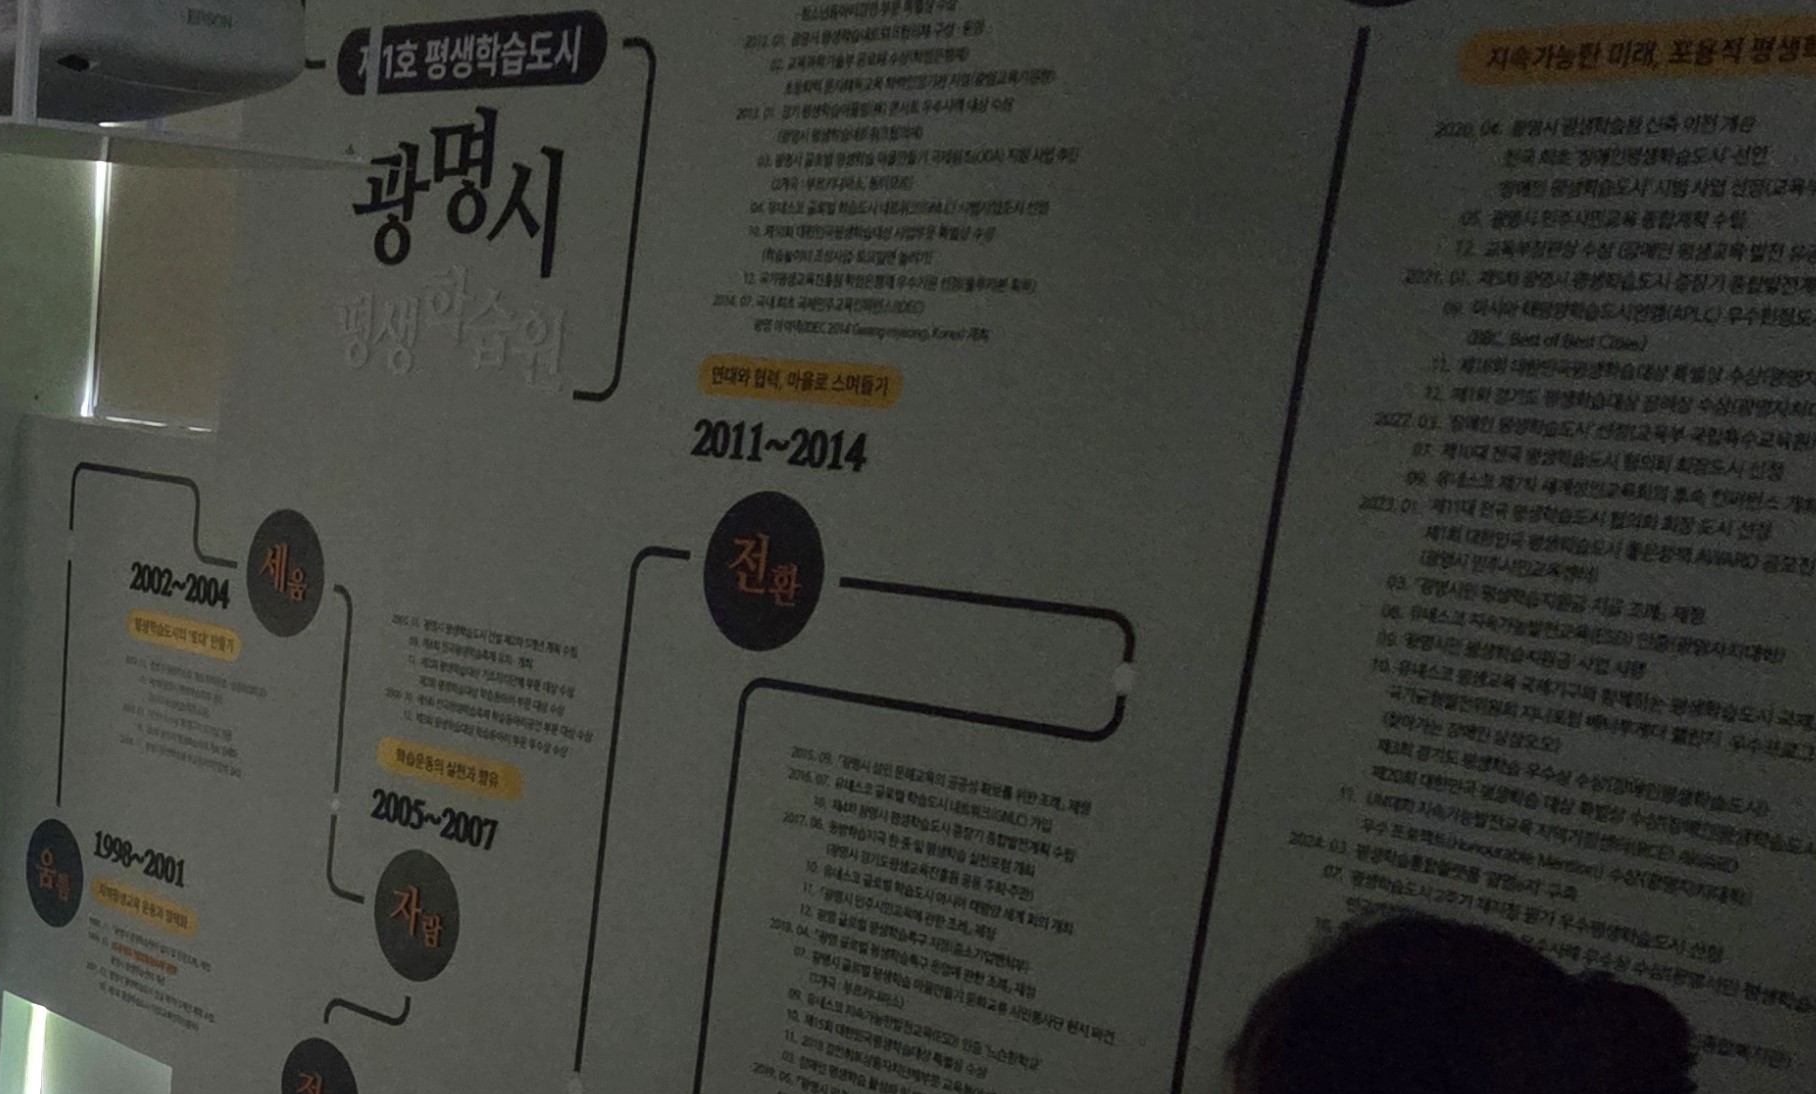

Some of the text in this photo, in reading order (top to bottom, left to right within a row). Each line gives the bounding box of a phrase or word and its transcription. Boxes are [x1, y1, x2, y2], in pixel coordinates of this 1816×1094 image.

[424, 24, 583, 80] 평생학습도시
[1486, 41, 1602, 71] 지속가능한
[1668, 35, 1745, 67] 포용적
[352, 106, 565, 278] 광명시
[336, 263, 567, 393] 평생학습원
[712, 365, 890, 397] 연대와 협력, 마을로 스며들기
[690, 418, 868, 472] 2011~2014
[130, 561, 231, 609] 2002~2004
[257, 542, 309, 603] 세움
[728, 531, 801, 608] 전환
[396, 747, 444, 777] 학습운동의
[446, 761, 477, 784] 실천과
[370, 788, 499, 851] 2005~2007
[94, 830, 186, 889] 1998~2001
[391, 884, 444, 950] 자람
